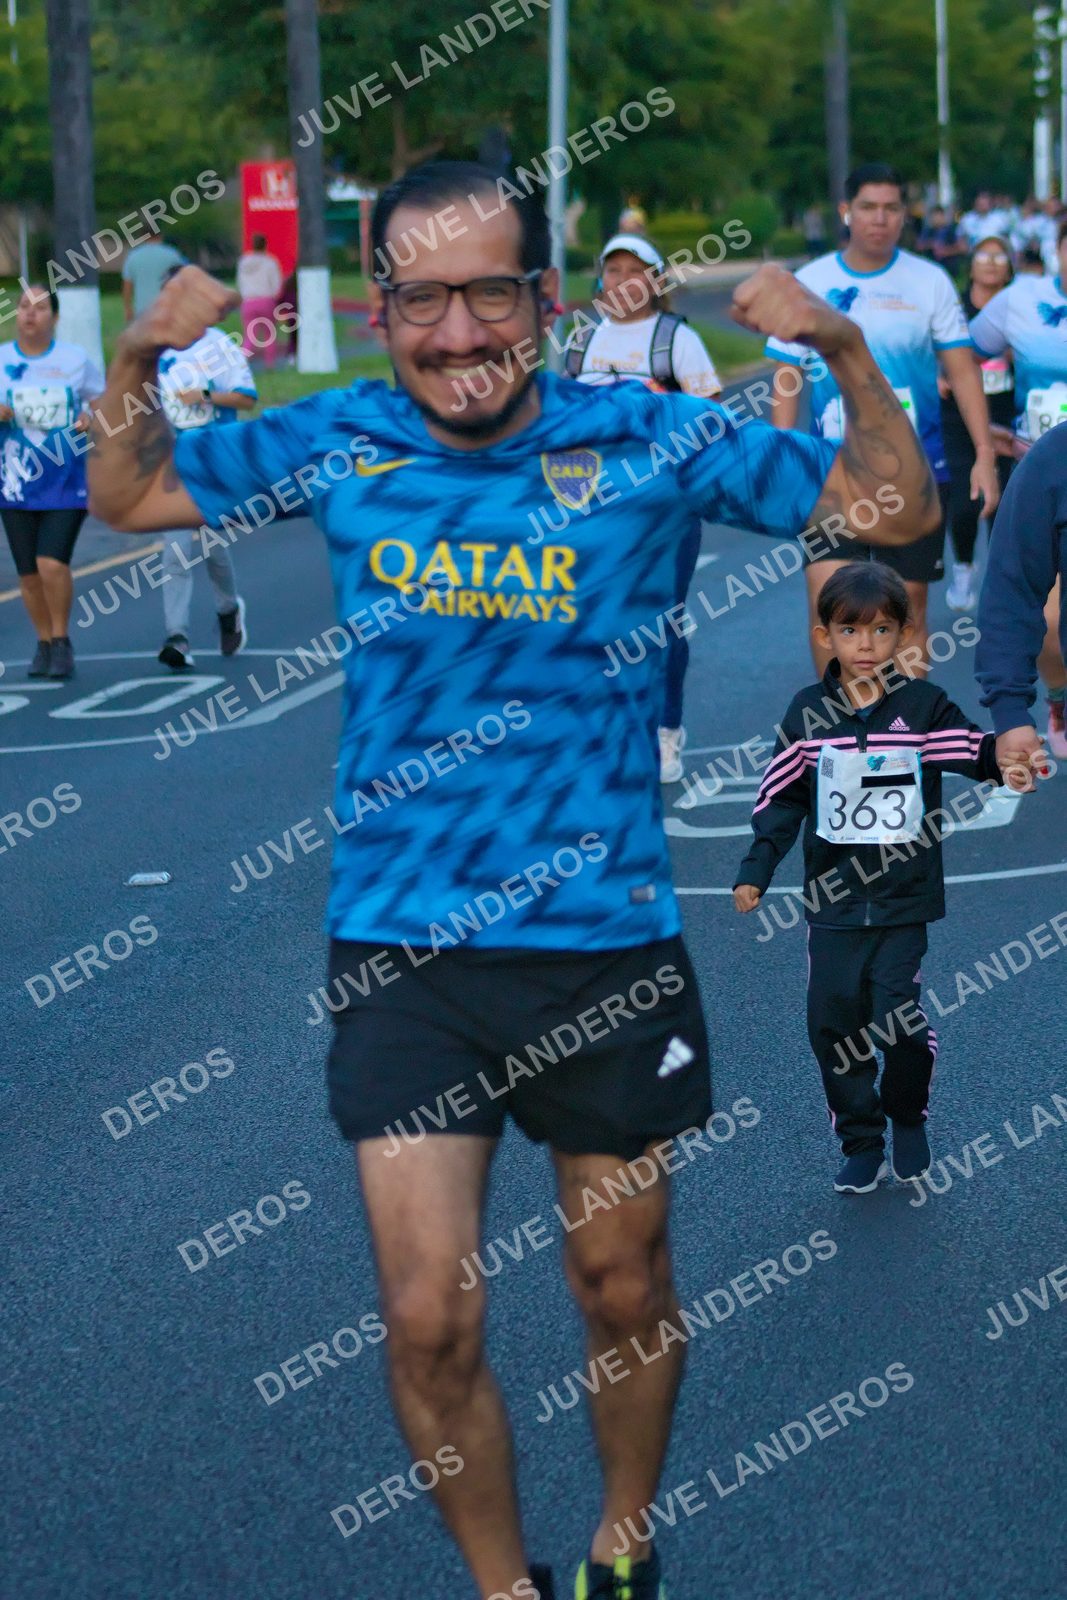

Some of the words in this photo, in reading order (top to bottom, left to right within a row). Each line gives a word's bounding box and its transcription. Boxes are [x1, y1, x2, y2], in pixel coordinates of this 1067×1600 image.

[369, 538, 577, 595] QATAR
[419, 588, 578, 623] AIRWAYS
[828, 789, 906, 831] 363
